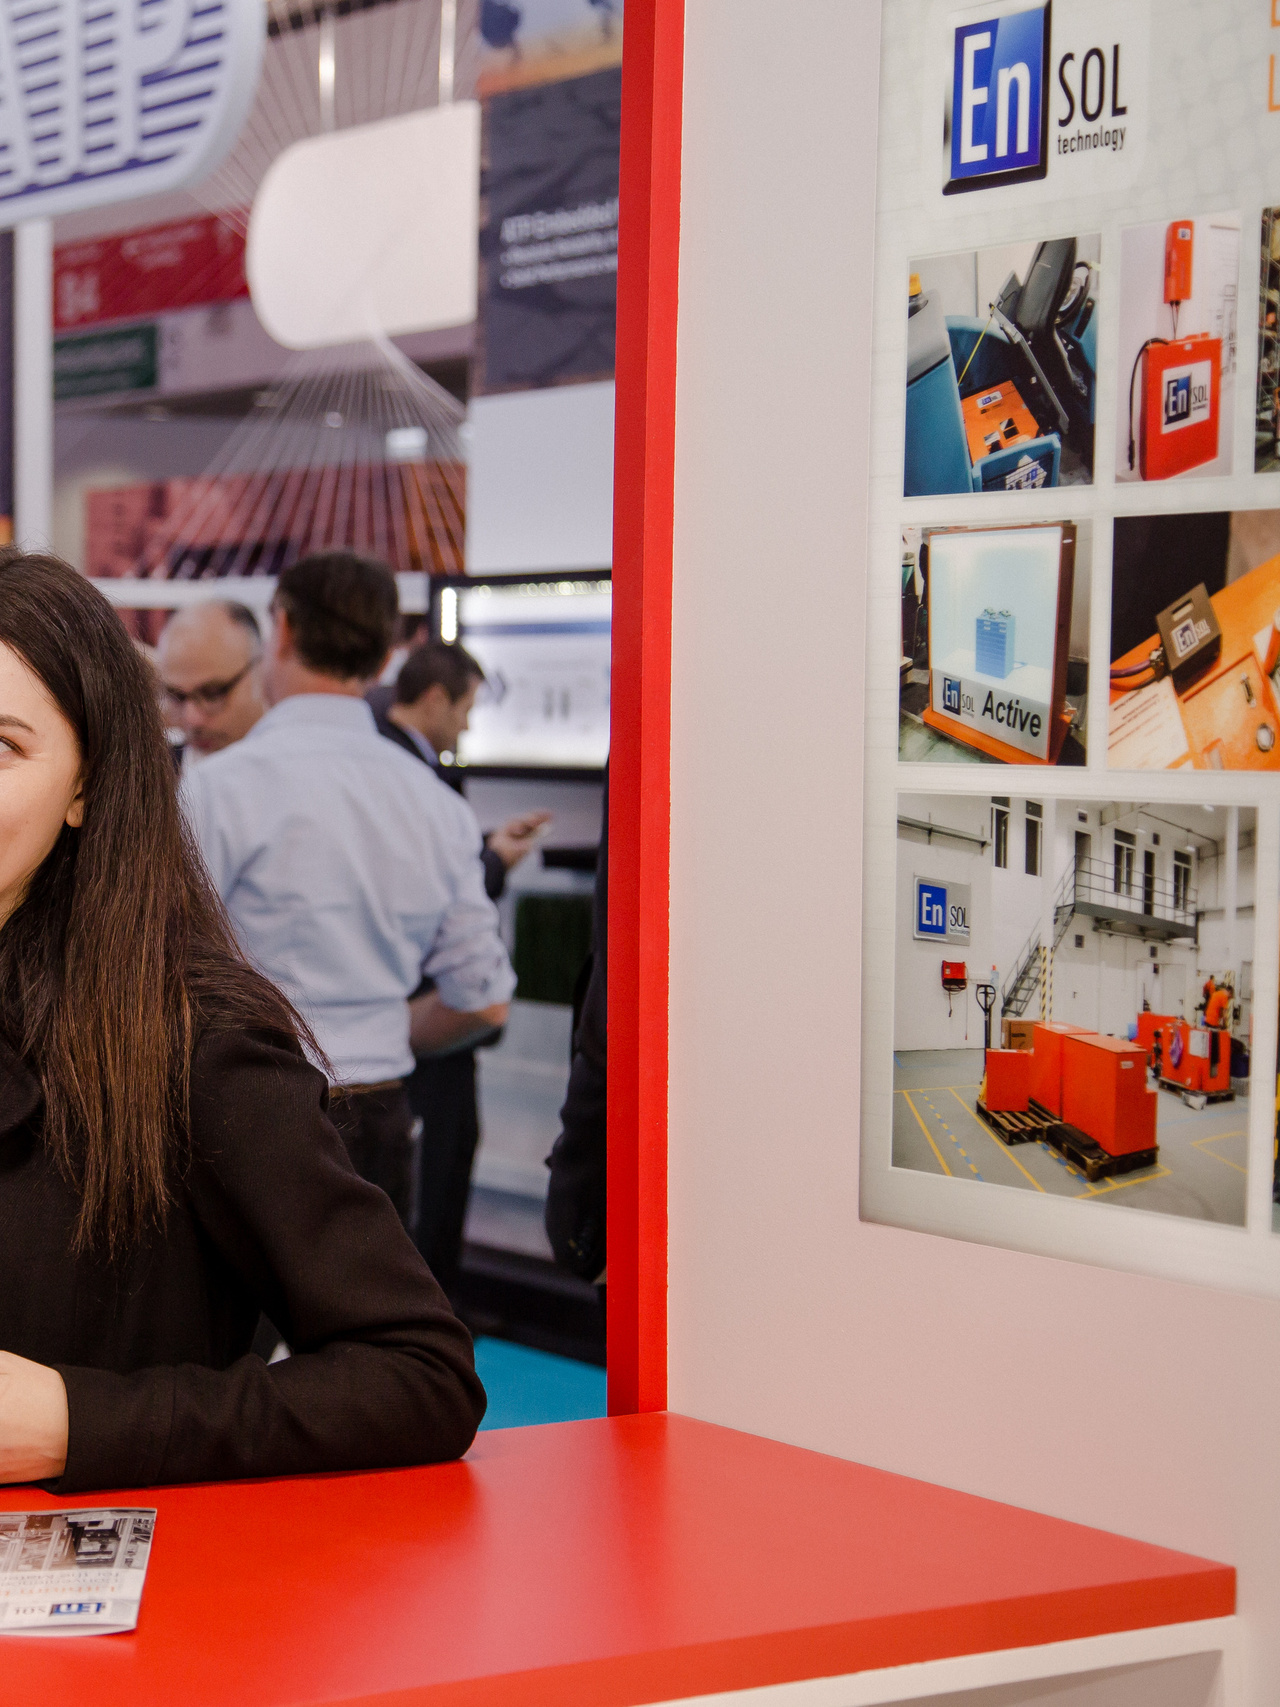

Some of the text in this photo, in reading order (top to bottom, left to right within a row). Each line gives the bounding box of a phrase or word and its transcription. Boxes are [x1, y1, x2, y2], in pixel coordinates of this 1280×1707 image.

[960, 31, 1128, 164] En SOL
[1057, 125, 1127, 155] technology
[1168, 381, 1188, 417] En
[945, 678, 958, 709] En
[981, 690, 1042, 738] Active
[922, 892, 970, 929] En SOL
